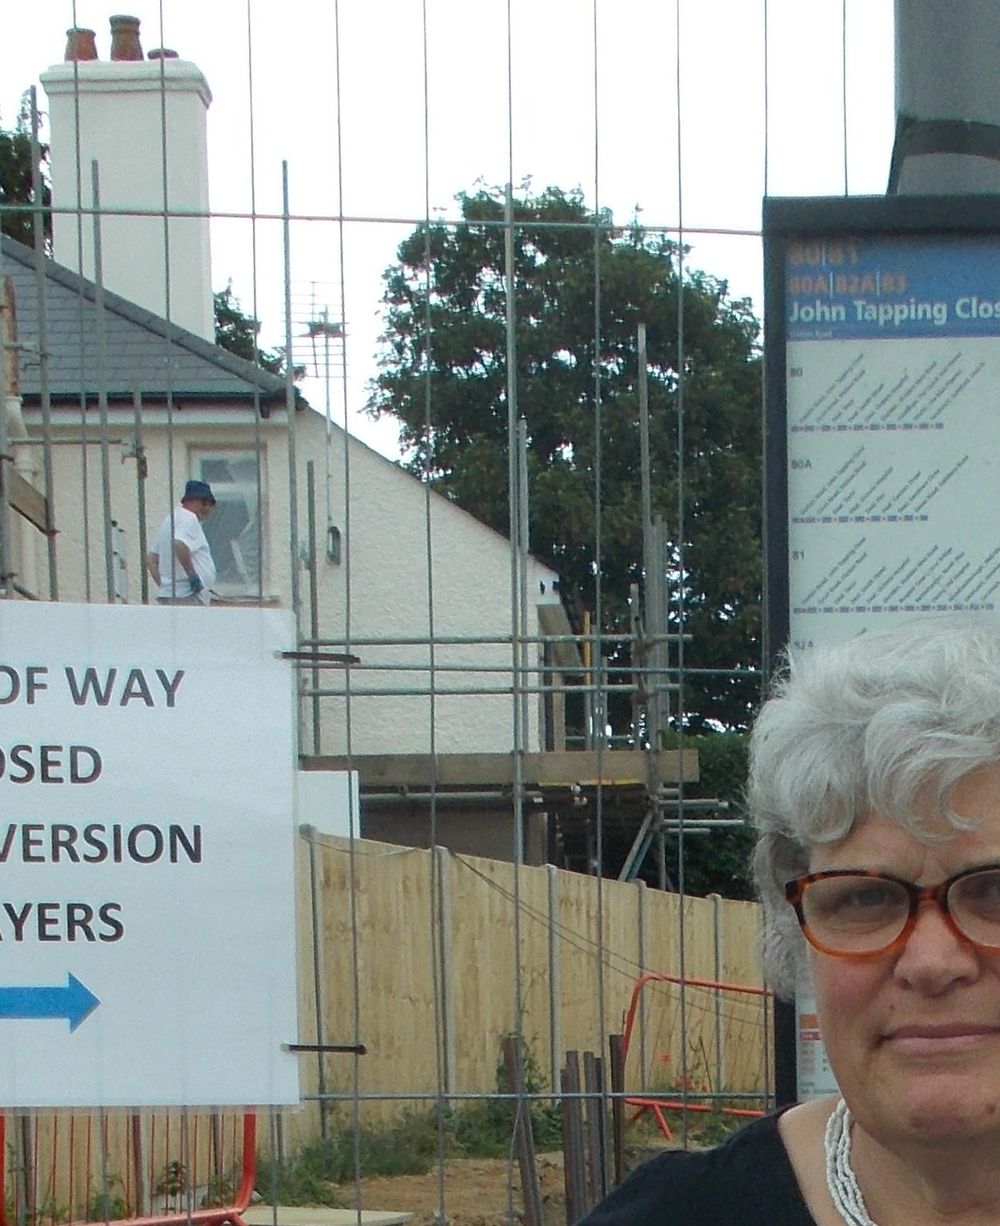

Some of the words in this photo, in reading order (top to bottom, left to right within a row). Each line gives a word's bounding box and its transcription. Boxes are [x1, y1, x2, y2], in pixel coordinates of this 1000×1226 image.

[789, 300, 846, 323] John
[854, 299, 948, 326] Tapping
[0, 666, 48, 705] OF
[65, 667, 186, 708] WAY
[0, 902, 125, 943] YERS
